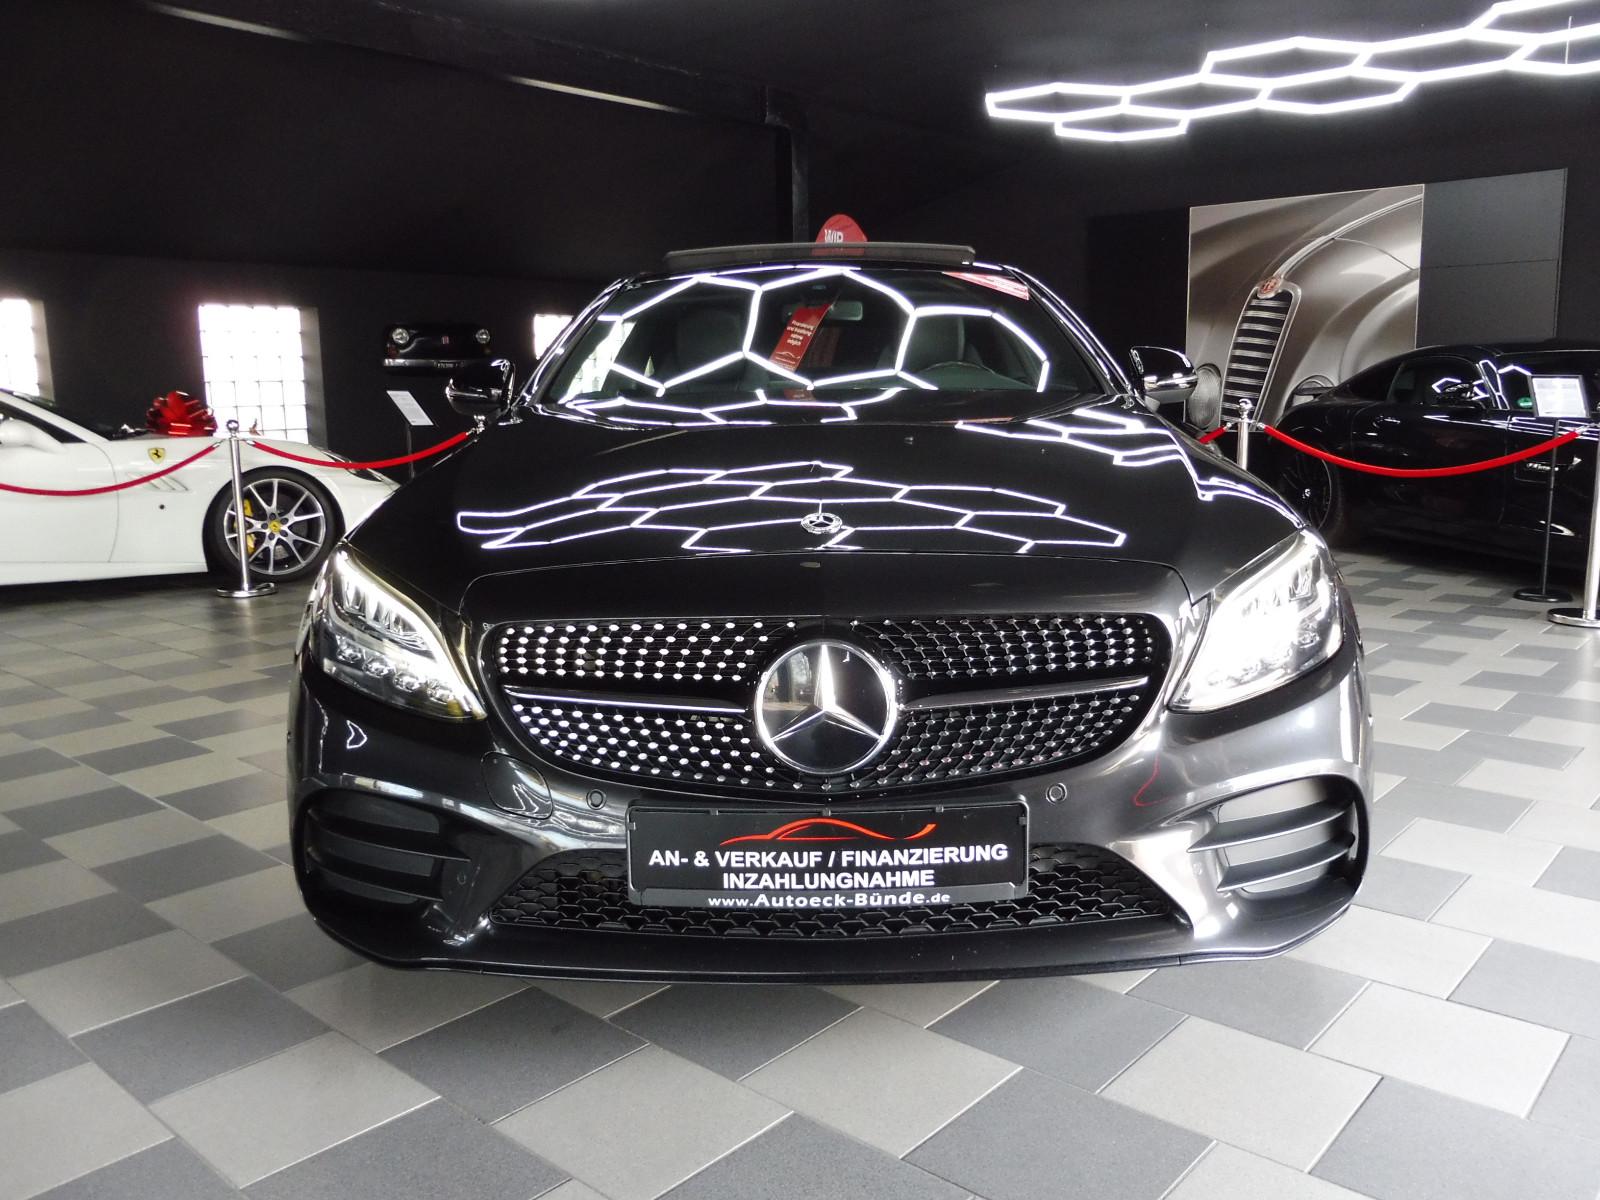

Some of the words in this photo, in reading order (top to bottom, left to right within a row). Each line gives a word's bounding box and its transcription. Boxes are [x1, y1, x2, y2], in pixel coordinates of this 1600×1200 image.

[648, 849, 689, 867] AN-
[693, 850, 710, 868] &
[714, 850, 823, 868] VERKAUF
[827, 850, 836, 867] /
[841, 843, 1009, 868] FINANZIERUNG
[721, 869, 935, 890] INZAHLUNGNAHME
[706, 890, 951, 909] www.Autoeck-Bünde.de
